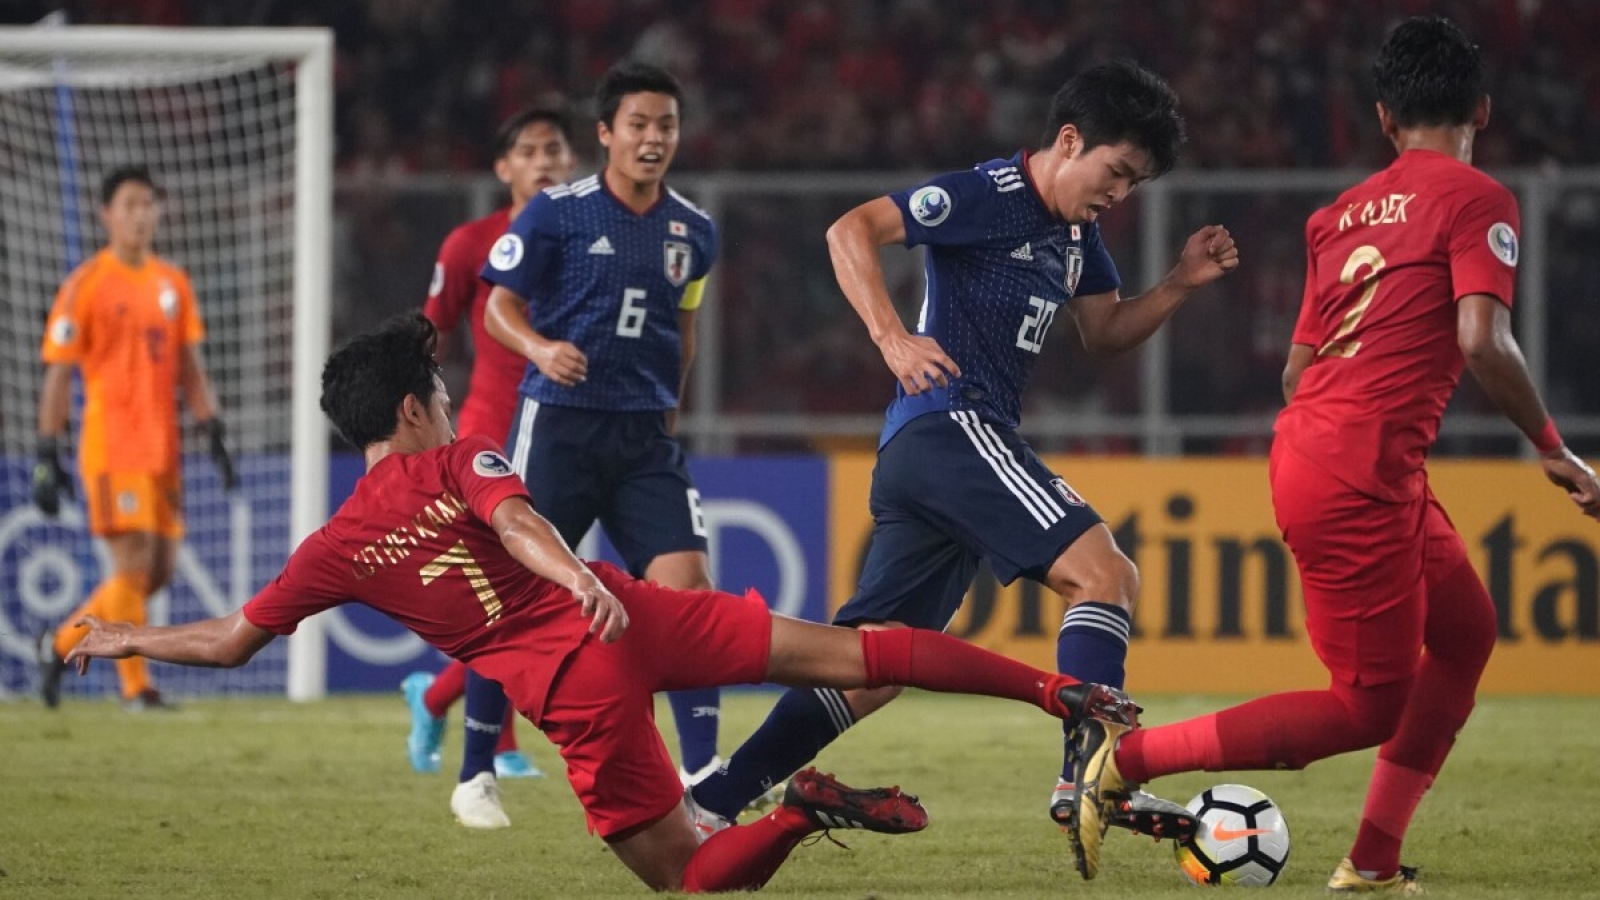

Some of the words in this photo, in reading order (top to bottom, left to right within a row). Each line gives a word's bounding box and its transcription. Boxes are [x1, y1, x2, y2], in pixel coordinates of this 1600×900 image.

[616, 287, 647, 338] 6
[1015, 295, 1059, 354] 20
[1318, 245, 1386, 358] 2
[419, 538, 502, 627] 7
